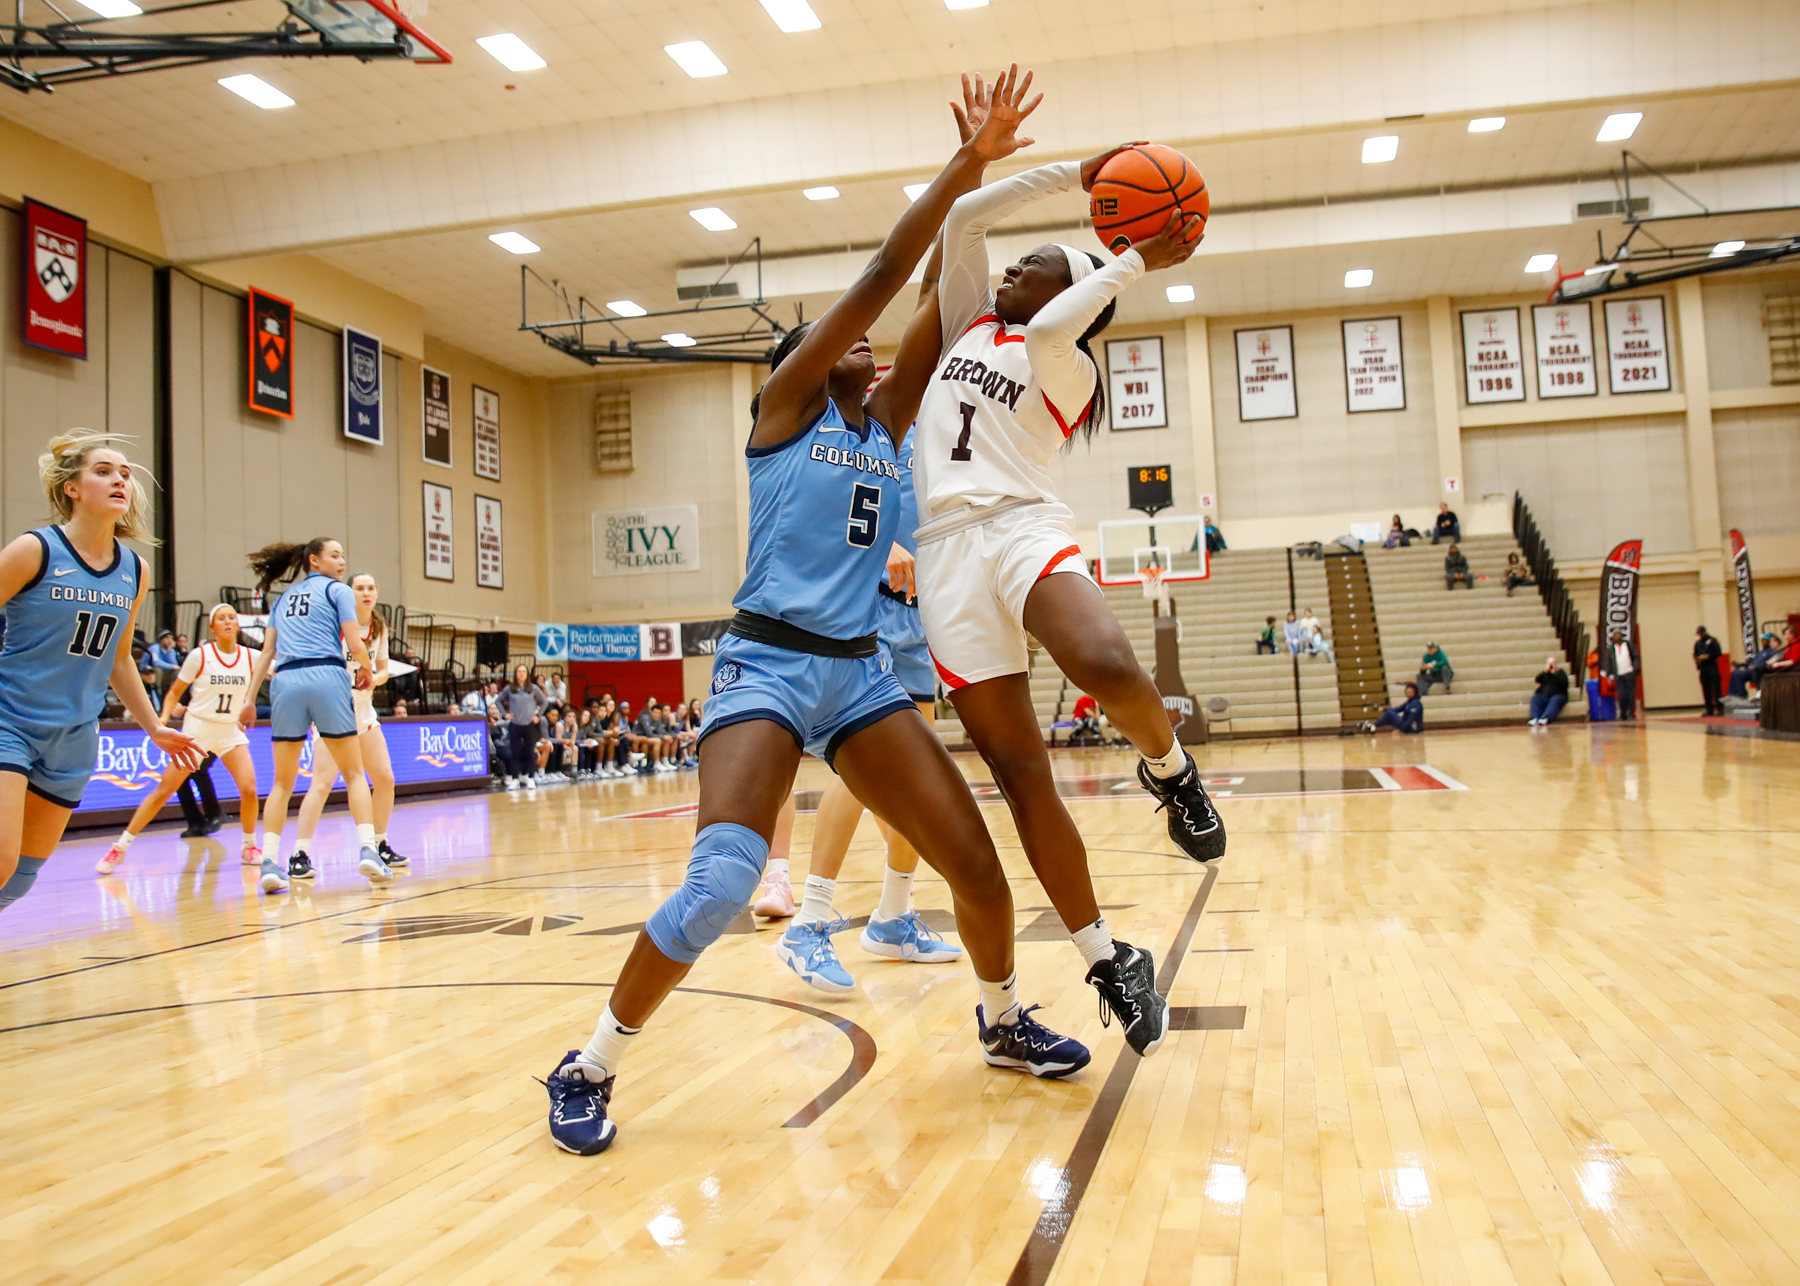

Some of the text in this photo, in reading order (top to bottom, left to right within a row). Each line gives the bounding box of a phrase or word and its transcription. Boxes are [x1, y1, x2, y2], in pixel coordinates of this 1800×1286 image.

[1549, 344, 1580, 356] NCAA
[1624, 340, 1650, 350] NCAA
[1478, 350, 1507, 362] NCAA
[1541, 356, 1590, 366] TOURNAMENT
[1350, 364, 1399, 375] TEAM FINALIST
[1469, 362, 1518, 372] TOURNAMENT
[1622, 366, 1657, 381] 2021
[941, 356, 1026, 411] BROWN
[1244, 373, 1288, 384] CHAMPIONS
[1479, 377, 1512, 392] 1996
[1550, 371, 1584, 387] 1998
[1124, 381, 1148, 395] WBI
[1246, 386, 1264, 394] 2014
[1122, 403, 1154, 419] 2017
[950, 401, 977, 461] 1
[1139, 468, 1169, 483] 8:16
[1447, 480, 1456, 490] T
[1202, 496, 1211, 507] S
[626, 516, 647, 525] THE
[846, 481, 882, 550] 5
[626, 525, 681, 553] IVY
[626, 552, 684, 567] LEAGUE
[51, 586, 134, 612] COLUMBI
[285, 592, 312, 619] 35
[67, 610, 119, 660] 10
[570, 629, 638, 643] Performance
[649, 625, 675, 658] B
[570, 642, 638, 656] Physical Therapy
[210, 675, 246, 686] BROWN
[215, 693, 233, 714] 11
[419, 725, 482, 760] BayCoast
